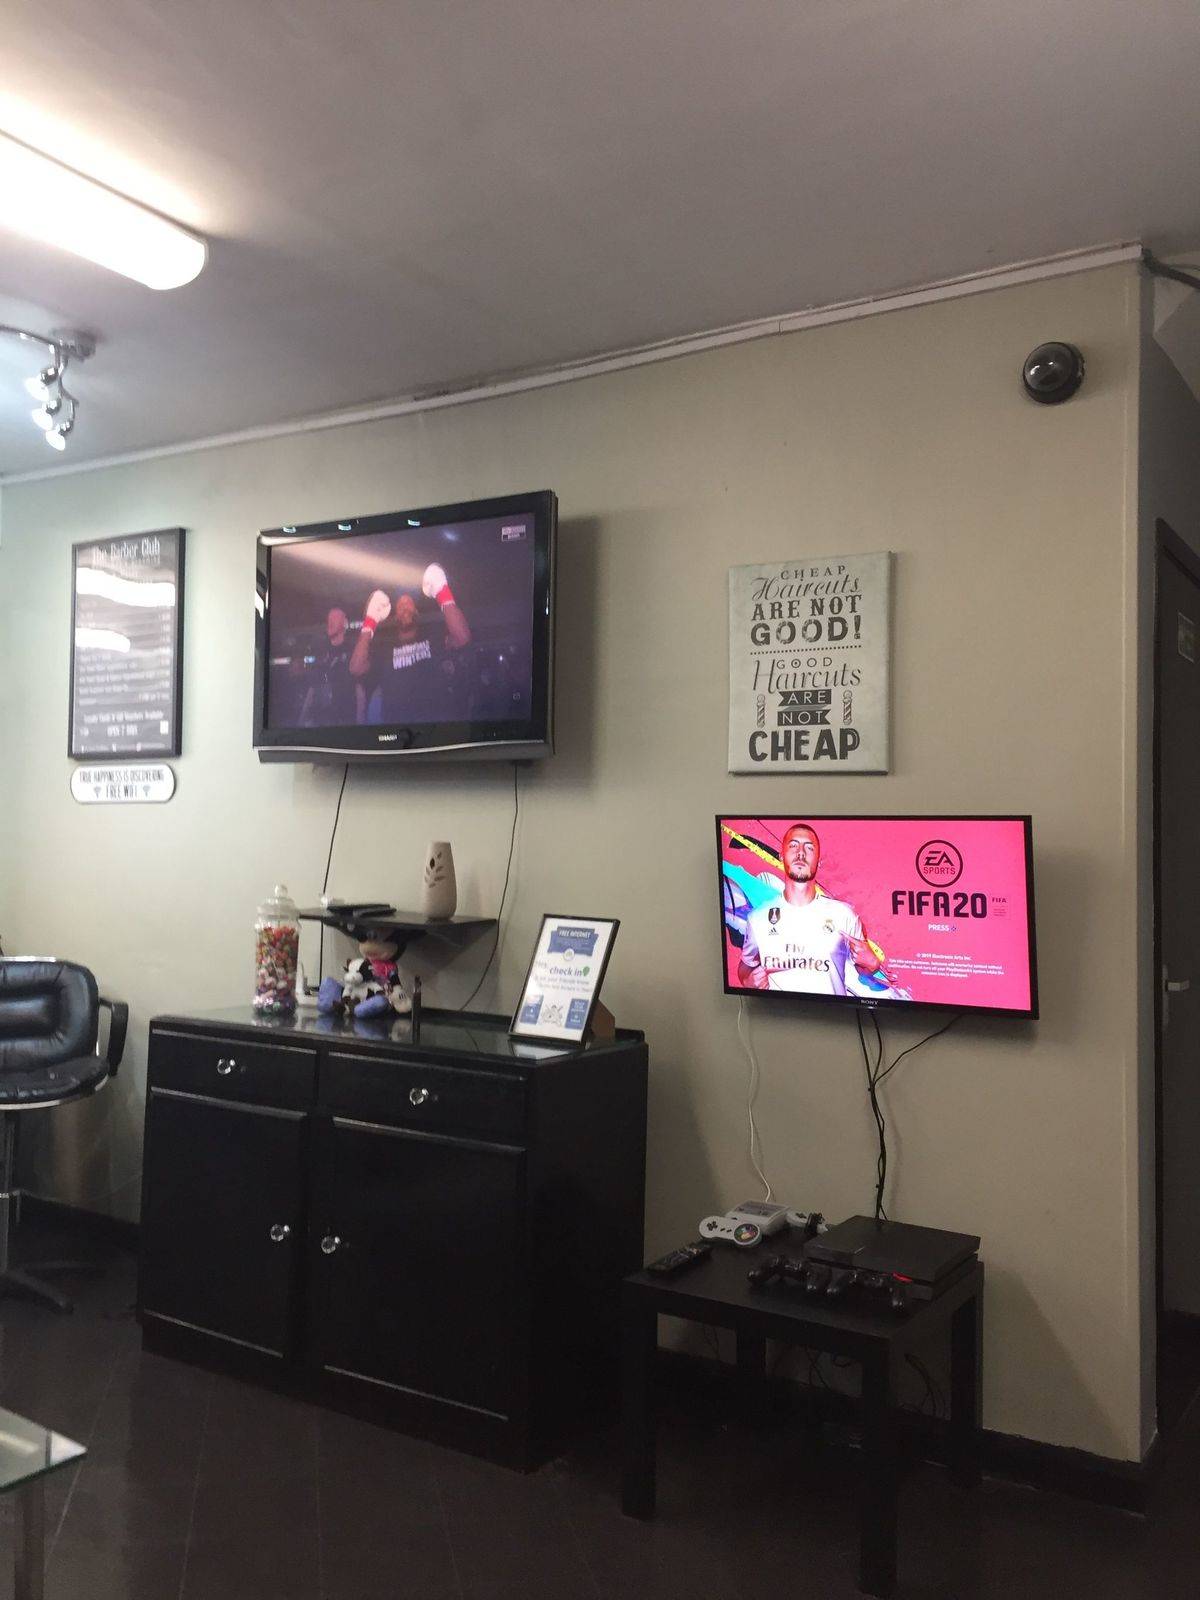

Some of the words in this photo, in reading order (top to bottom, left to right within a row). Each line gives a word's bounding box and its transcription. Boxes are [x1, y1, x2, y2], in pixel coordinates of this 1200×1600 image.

[141, 535, 160, 556] Club
[780, 565, 846, 580] CHEAP
[751, 574, 860, 601] Haircuts
[751, 599, 800, 621] ARE
[810, 594, 862, 616] NOT
[750, 615, 862, 646] GOOD!
[776, 656, 833, 670] GOOD
[752, 659, 862, 694] Haircuts
[787, 690, 826, 705] ARE
[781, 711, 823, 725] NOT
[748, 728, 861, 762] CHEAP
[93, 769, 123, 782] HAPPINESS
[130, 769, 164, 782] DISCOVERING
[106, 784, 121, 798] FREE
[924, 851, 954, 866] EA
[923, 866, 956, 875] SPORTS
[928, 923, 950, 931] PRESS
[549, 965, 573, 977] check
[574, 967, 583, 977] in
[764, 955, 830, 972] Emirates
